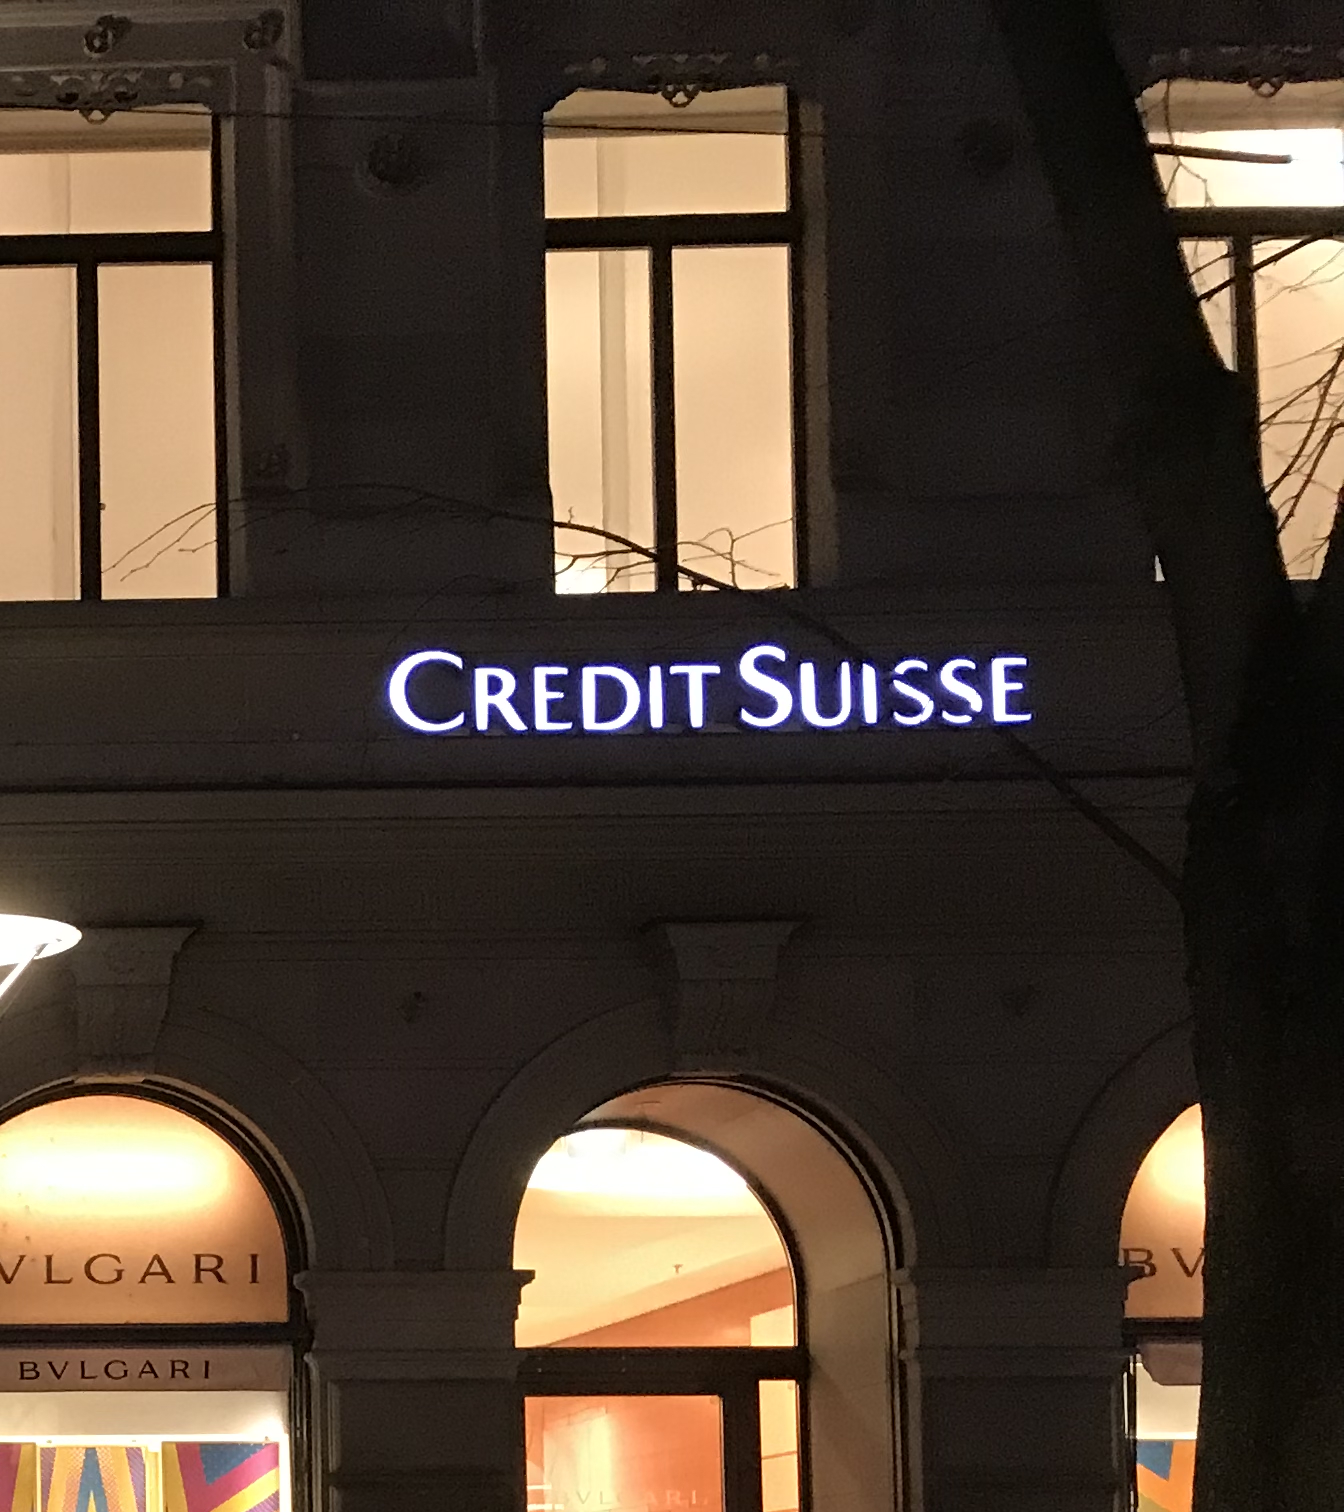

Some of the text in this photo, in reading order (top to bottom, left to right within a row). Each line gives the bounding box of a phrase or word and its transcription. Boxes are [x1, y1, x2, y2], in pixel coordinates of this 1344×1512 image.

[388, 644, 1033, 732] CREDIT SUISSE
[18, 1359, 211, 1381] BVLGARI
